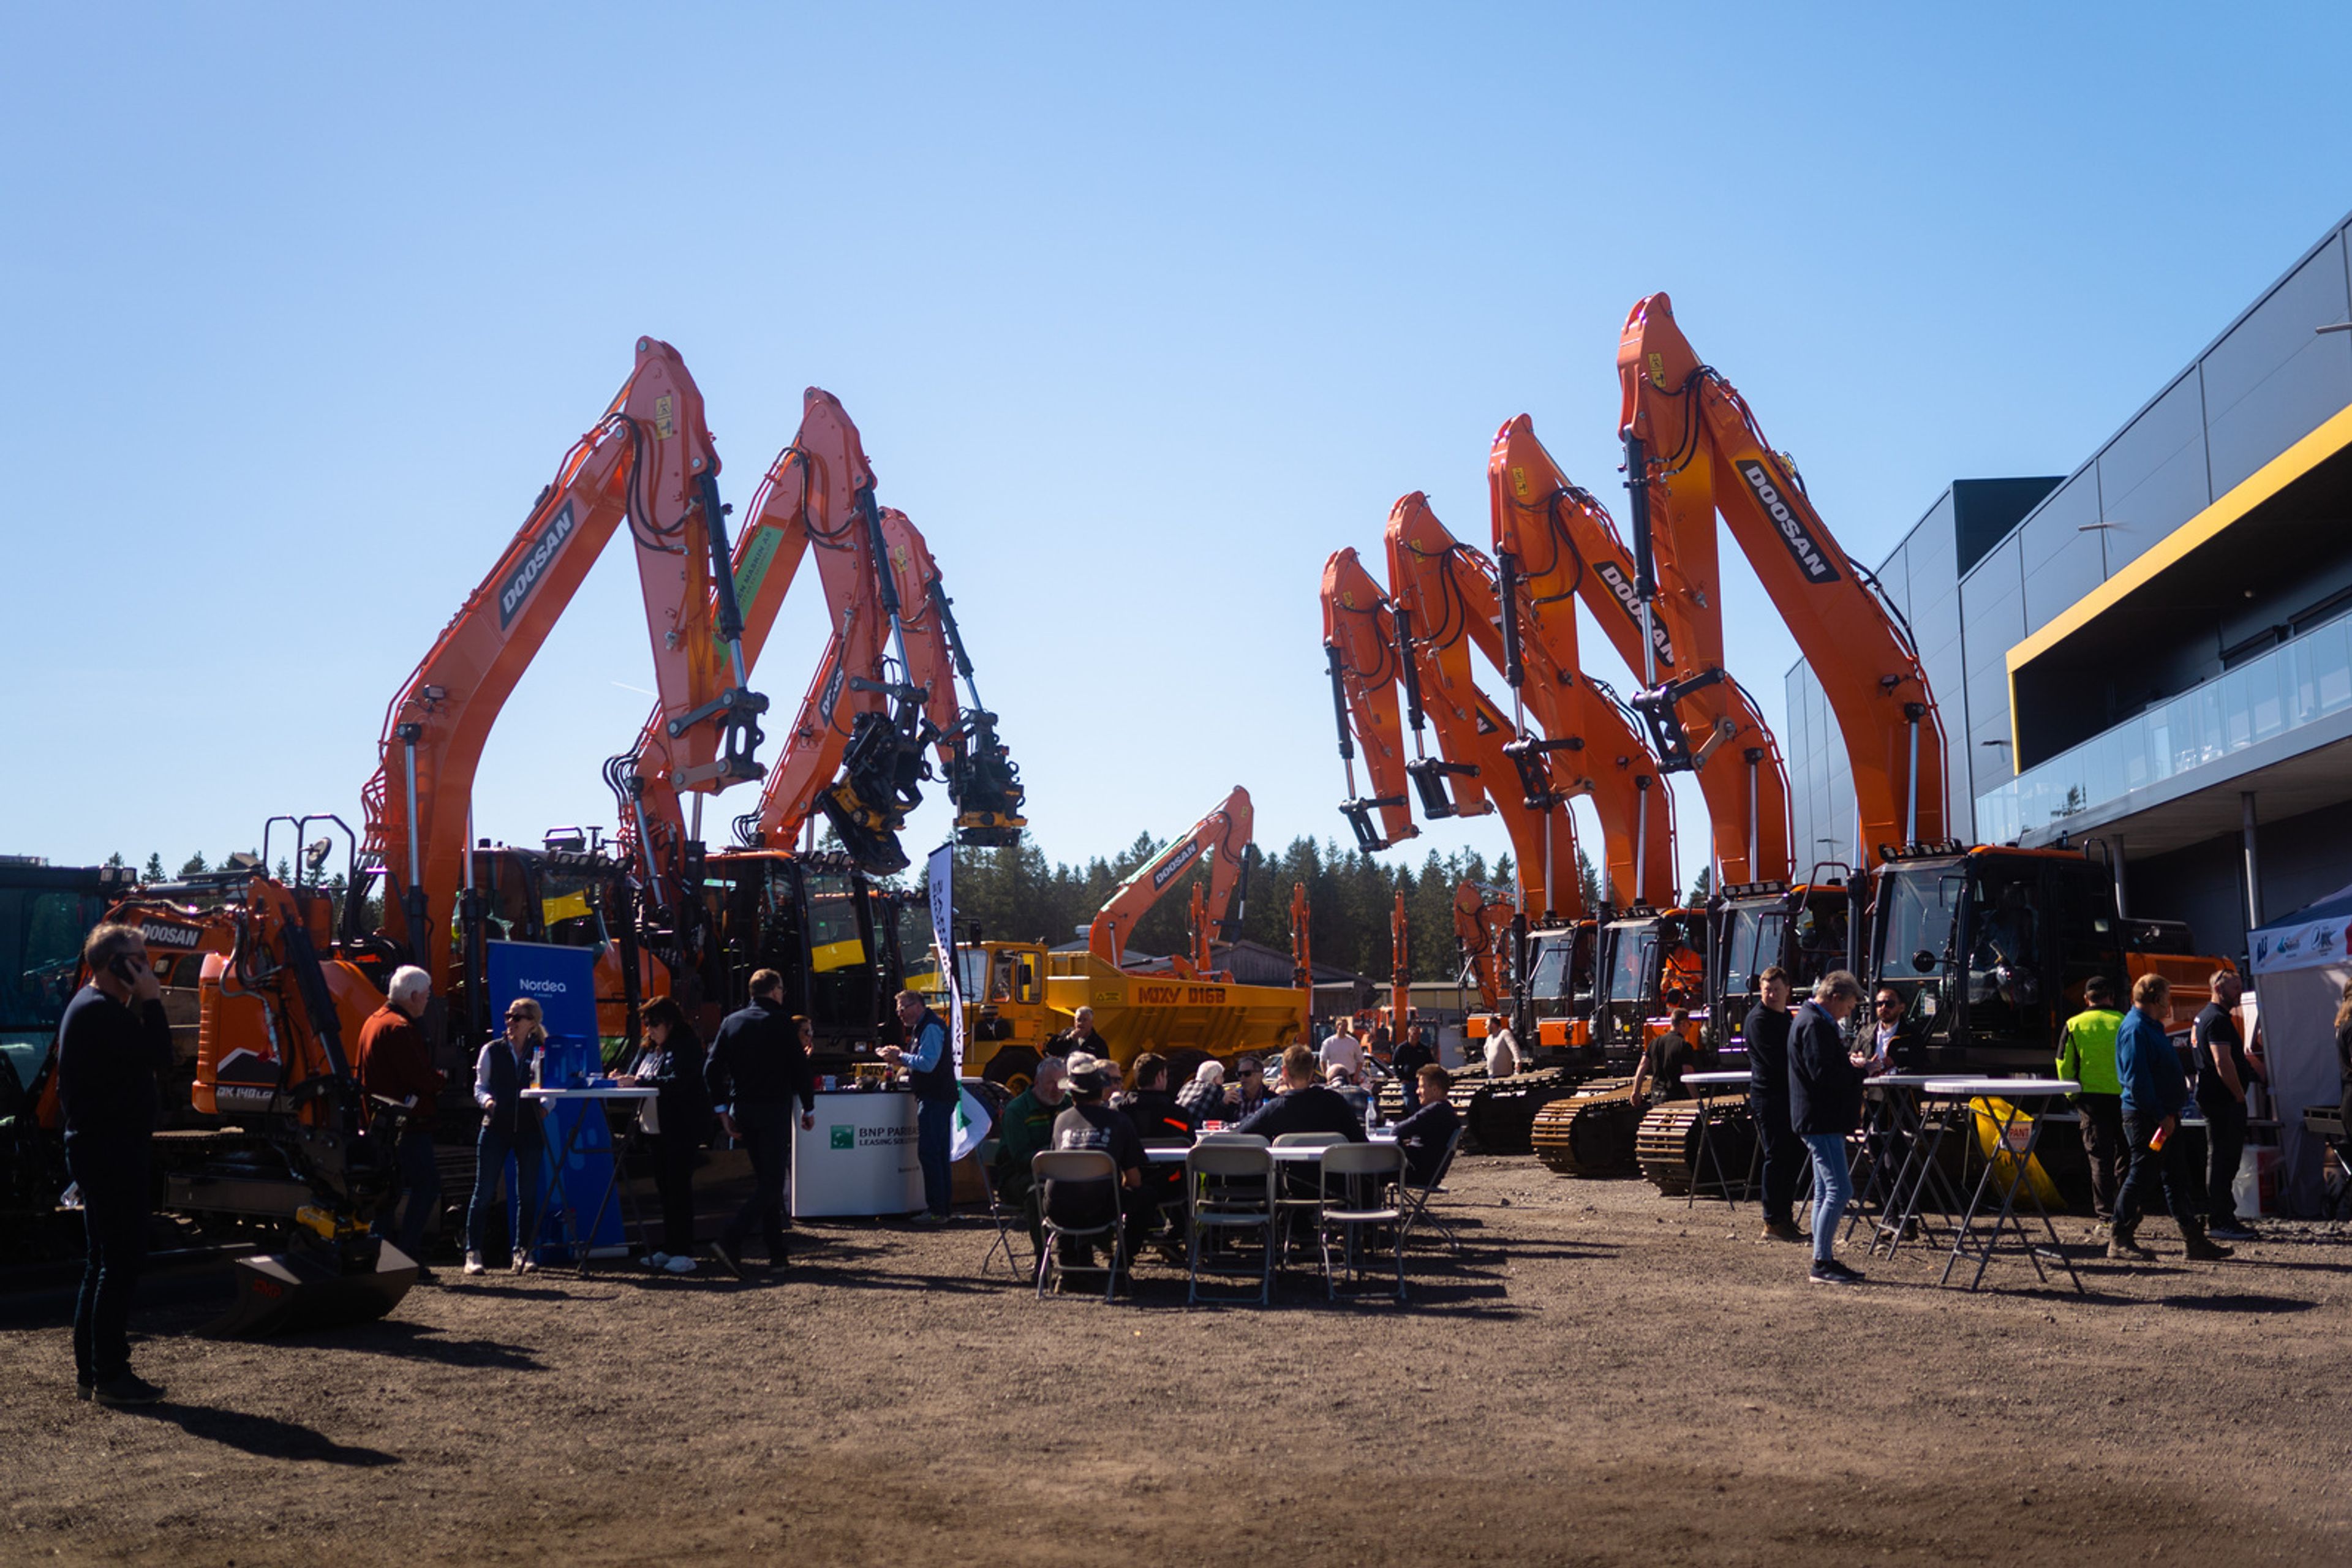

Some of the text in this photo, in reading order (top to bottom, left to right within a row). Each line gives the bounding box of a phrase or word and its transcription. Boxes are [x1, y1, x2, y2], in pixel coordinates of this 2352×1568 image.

[1745, 466, 1826, 576] DOOSAN
[503, 510, 571, 614] DOOSAN
[744, 545, 764, 583] MASKIN
[762, 530, 771, 545] AS
[1602, 566, 1675, 663] DOOAN
[1155, 843, 1197, 884] DOOSAN
[141, 924, 199, 946] DOOSAN
[519, 979, 566, 992] Nordea
[1139, 987, 1182, 1003] MOXY
[1188, 987, 1226, 1004] D16B
[859, 1127, 884, 1137] BNP
[2010, 1128, 2029, 1137] PANT
